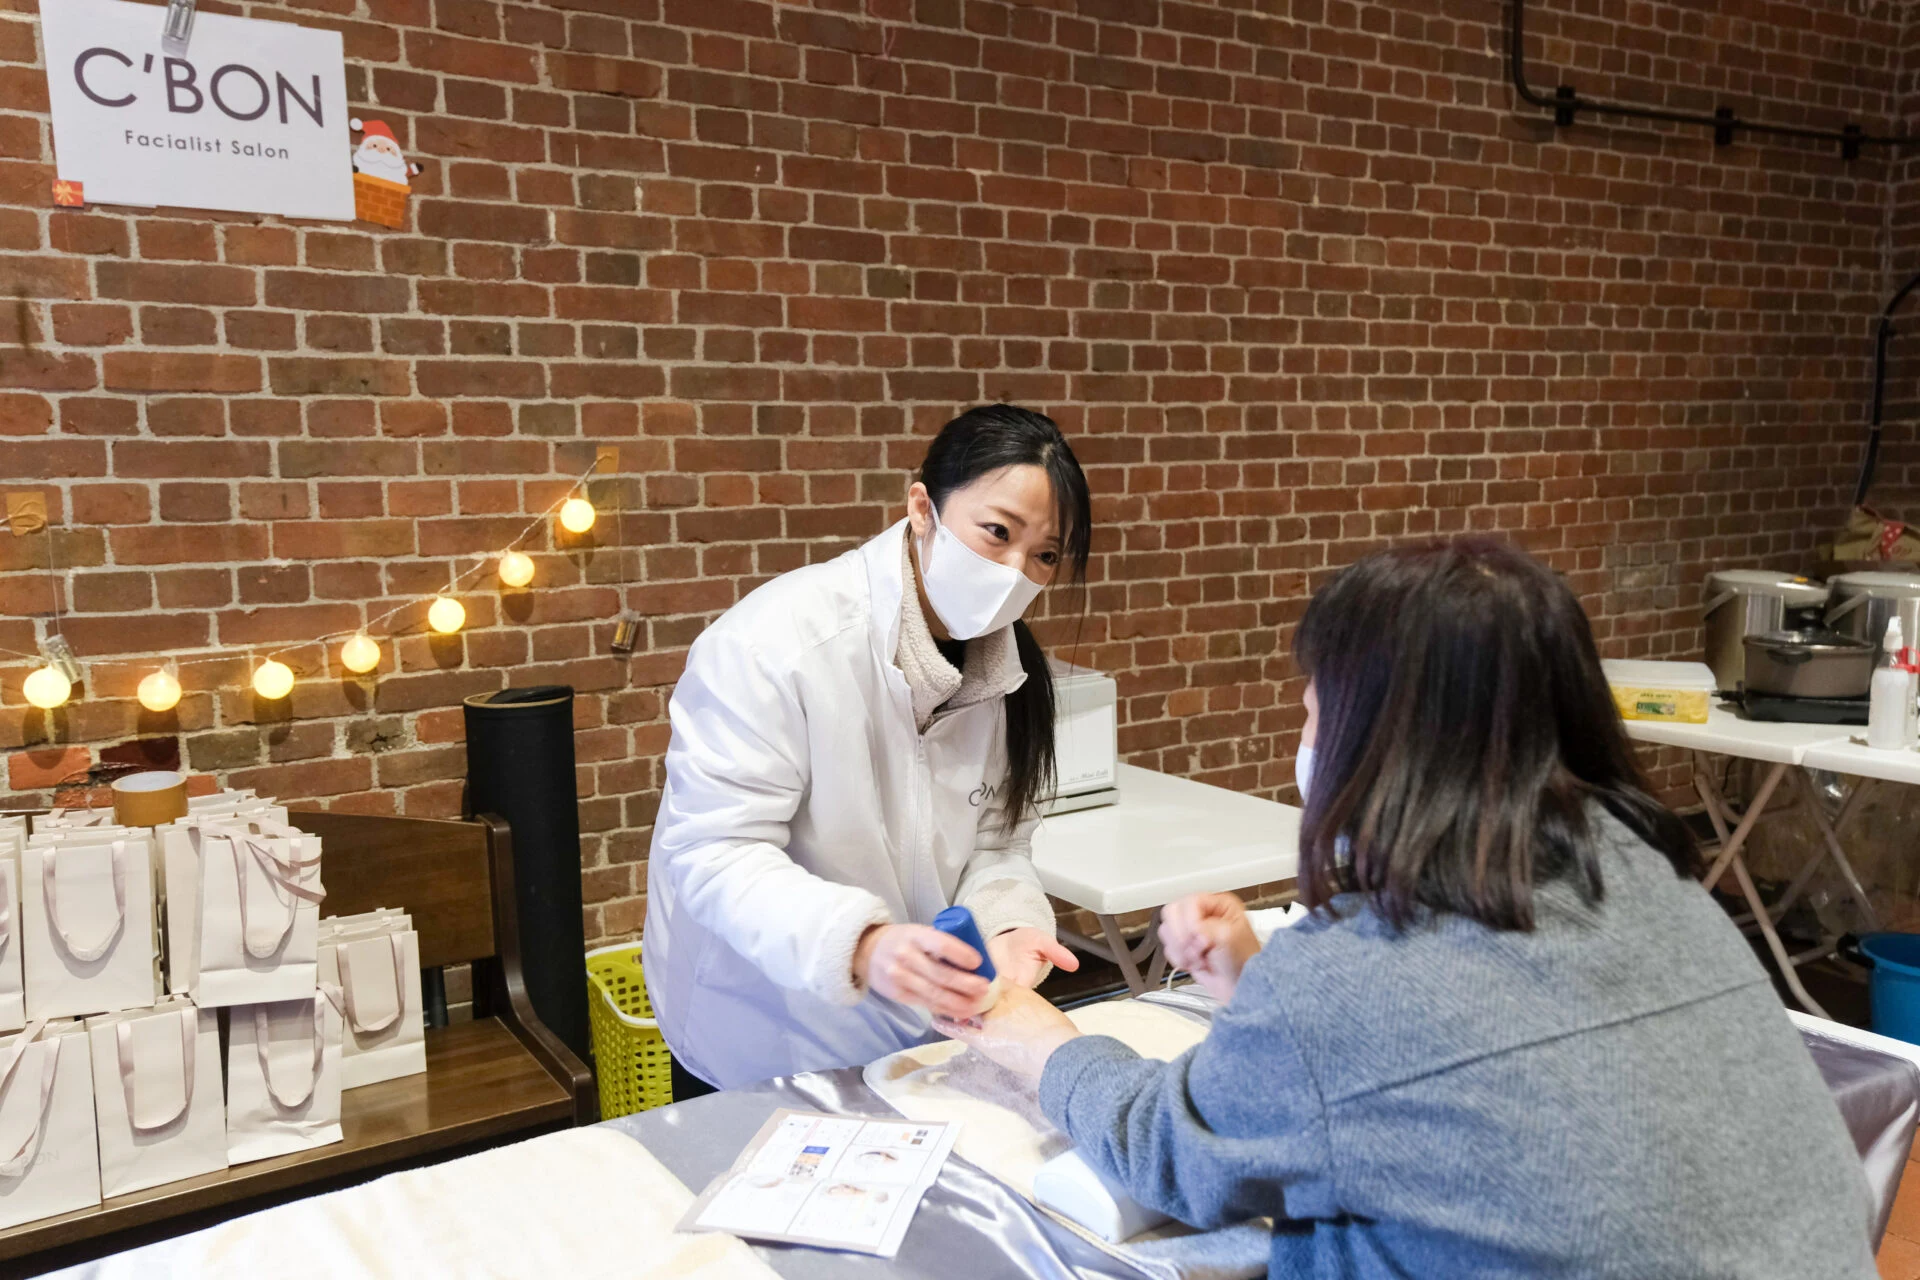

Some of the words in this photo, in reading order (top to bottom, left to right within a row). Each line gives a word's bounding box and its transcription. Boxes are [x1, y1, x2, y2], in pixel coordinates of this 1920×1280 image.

[74, 46, 324, 128] C'BON
[124, 129, 222, 154] Facialist
[231, 140, 290, 160] Salon
